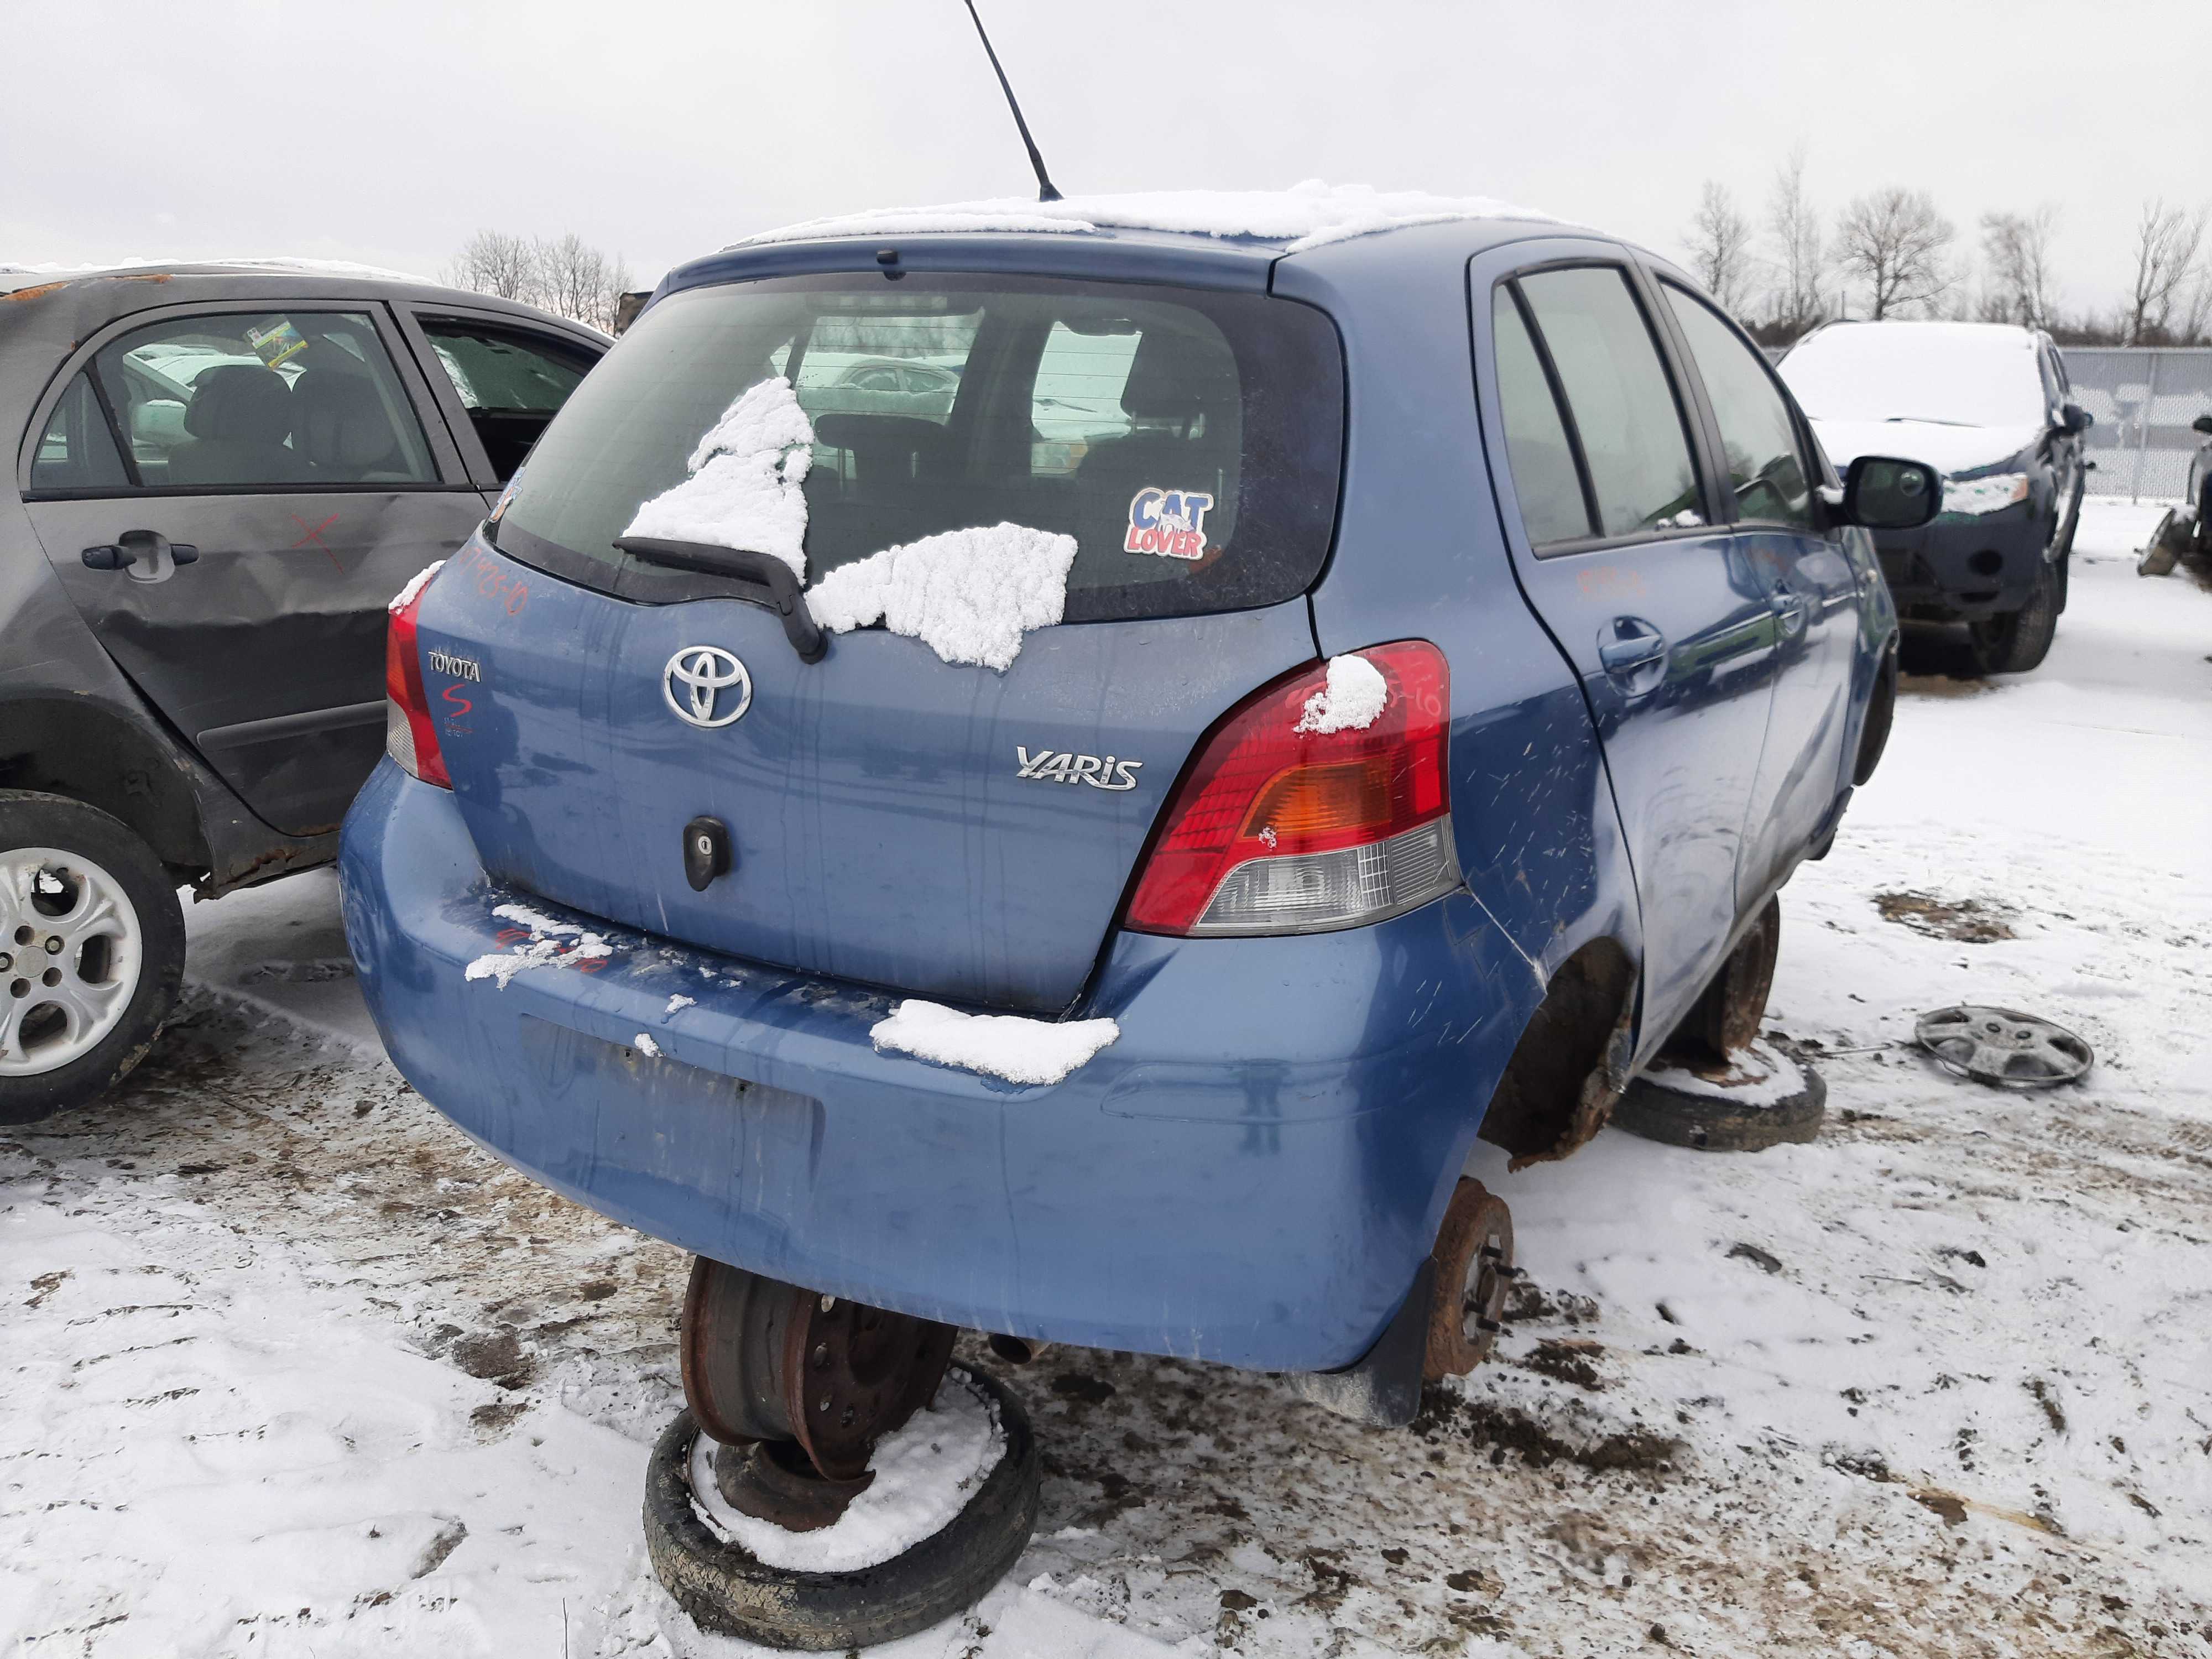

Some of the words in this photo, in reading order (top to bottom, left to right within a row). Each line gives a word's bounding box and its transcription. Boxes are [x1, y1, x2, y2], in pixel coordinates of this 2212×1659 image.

[1133, 491, 1209, 530] CAT
[1127, 527, 1202, 557] LOVER
[427, 651, 482, 683] TOYOTA
